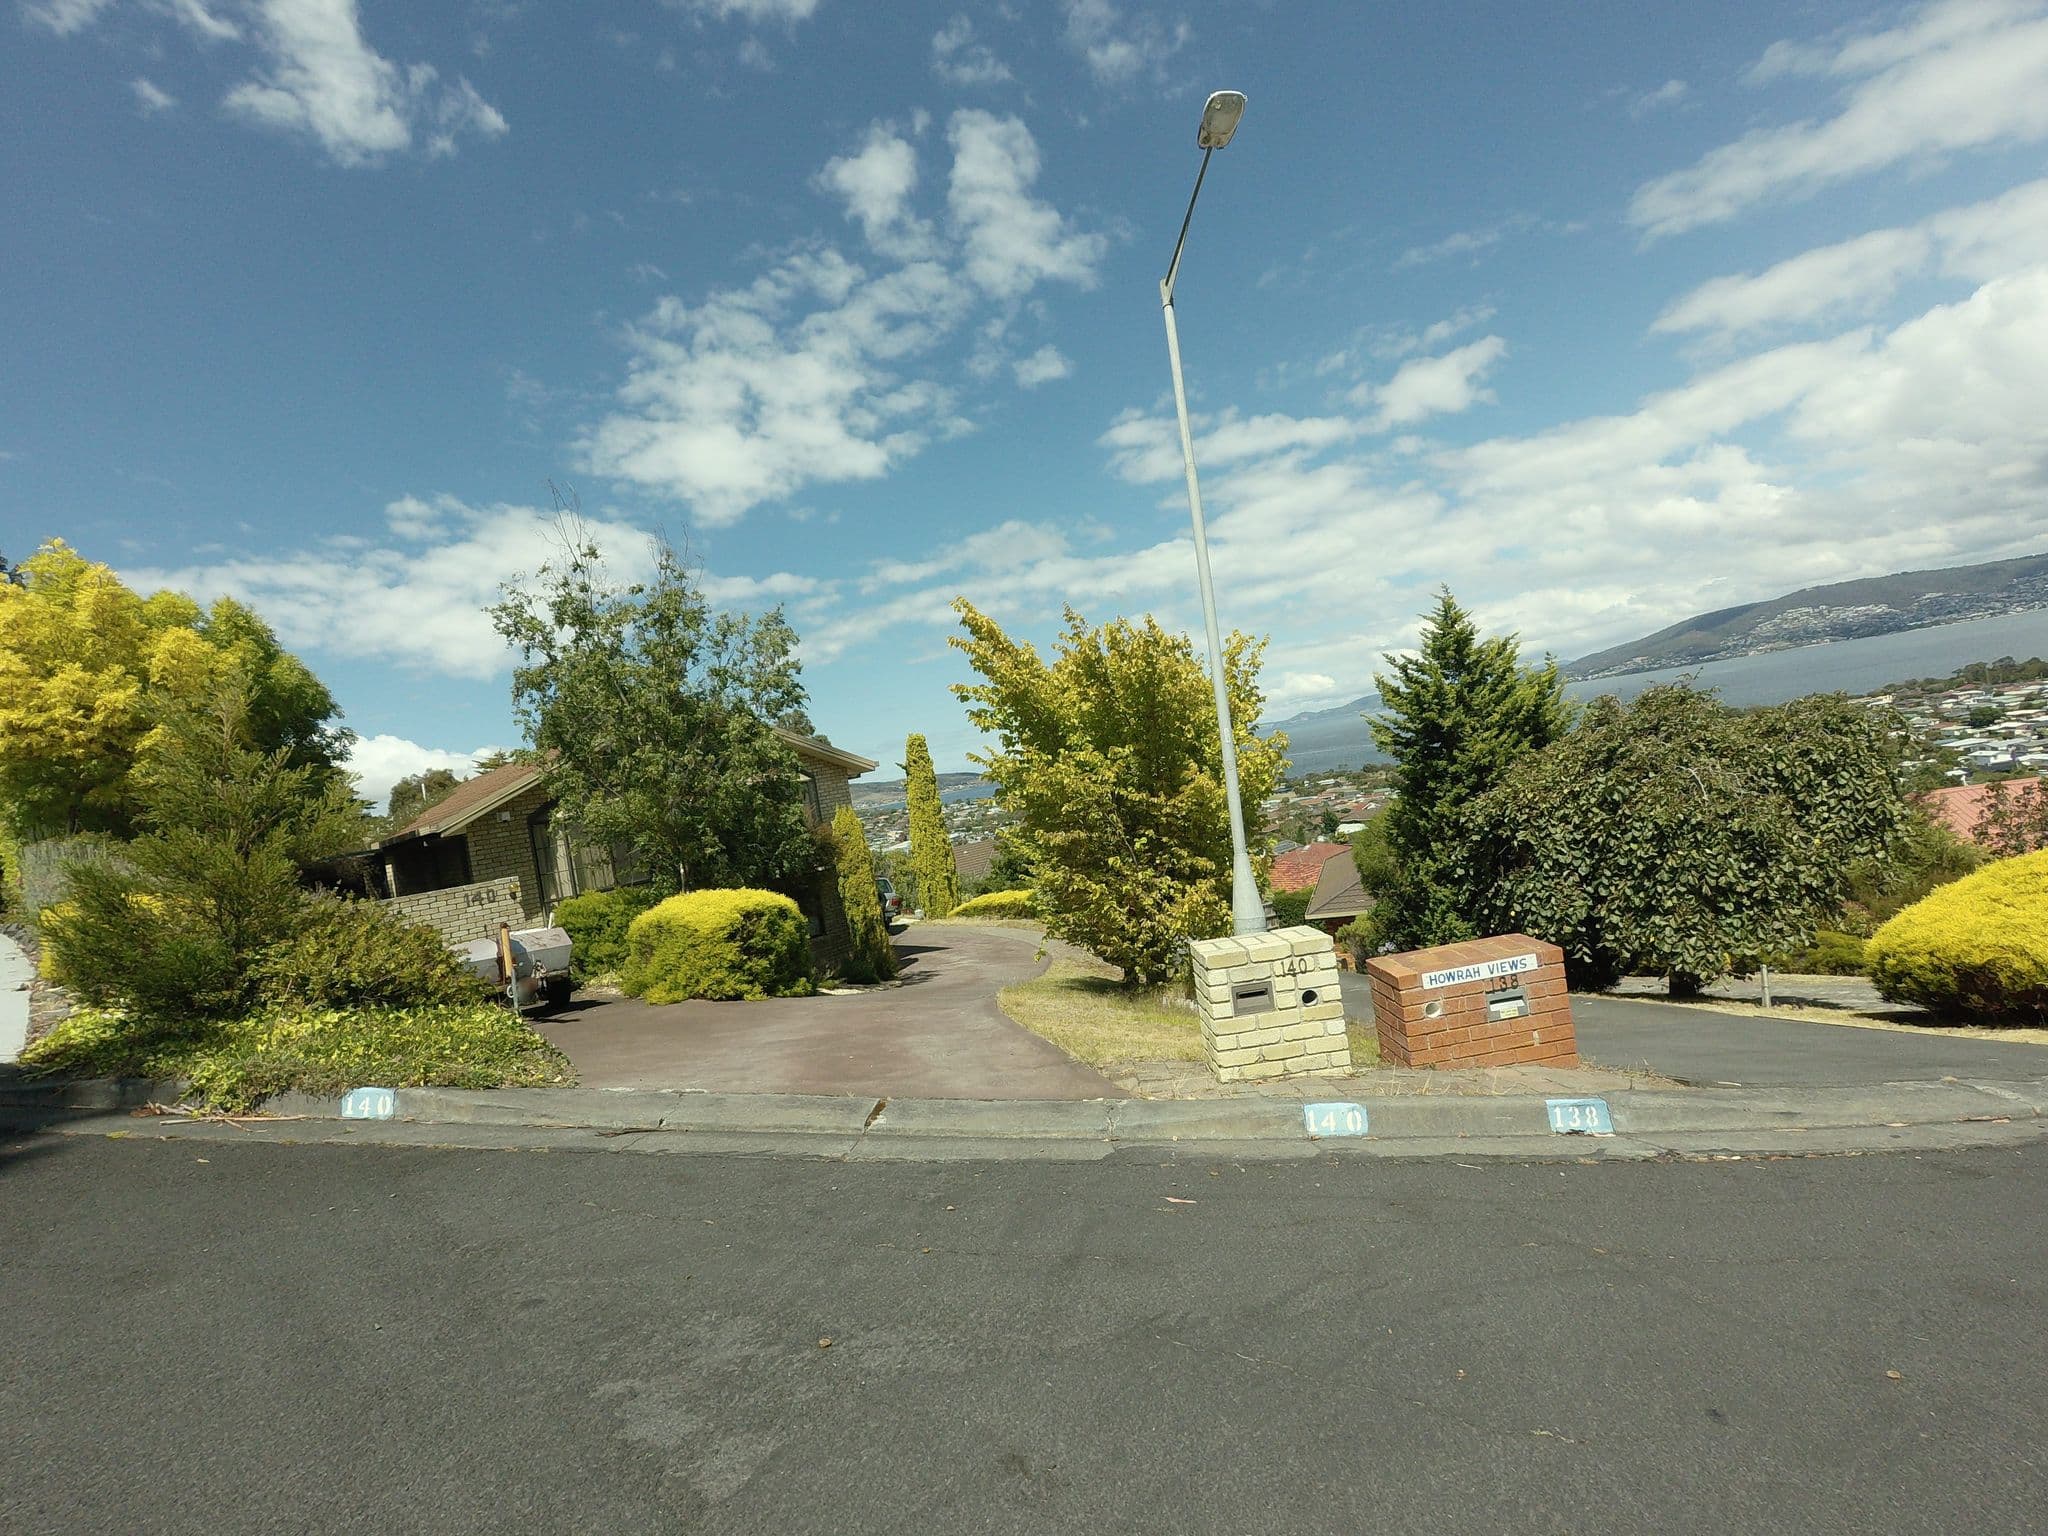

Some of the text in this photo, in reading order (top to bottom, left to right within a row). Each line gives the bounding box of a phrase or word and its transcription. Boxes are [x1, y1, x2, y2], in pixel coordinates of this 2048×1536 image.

[464, 889, 496, 906] 140
[1281, 958, 1307, 977] 140
[1429, 958, 1527, 986] HOWRAH VIEWS
[1489, 974, 1519, 993] 138
[345, 1095, 391, 1117] 140
[1553, 1105, 1599, 1128] 138
[1307, 1110, 1362, 1132] 140
